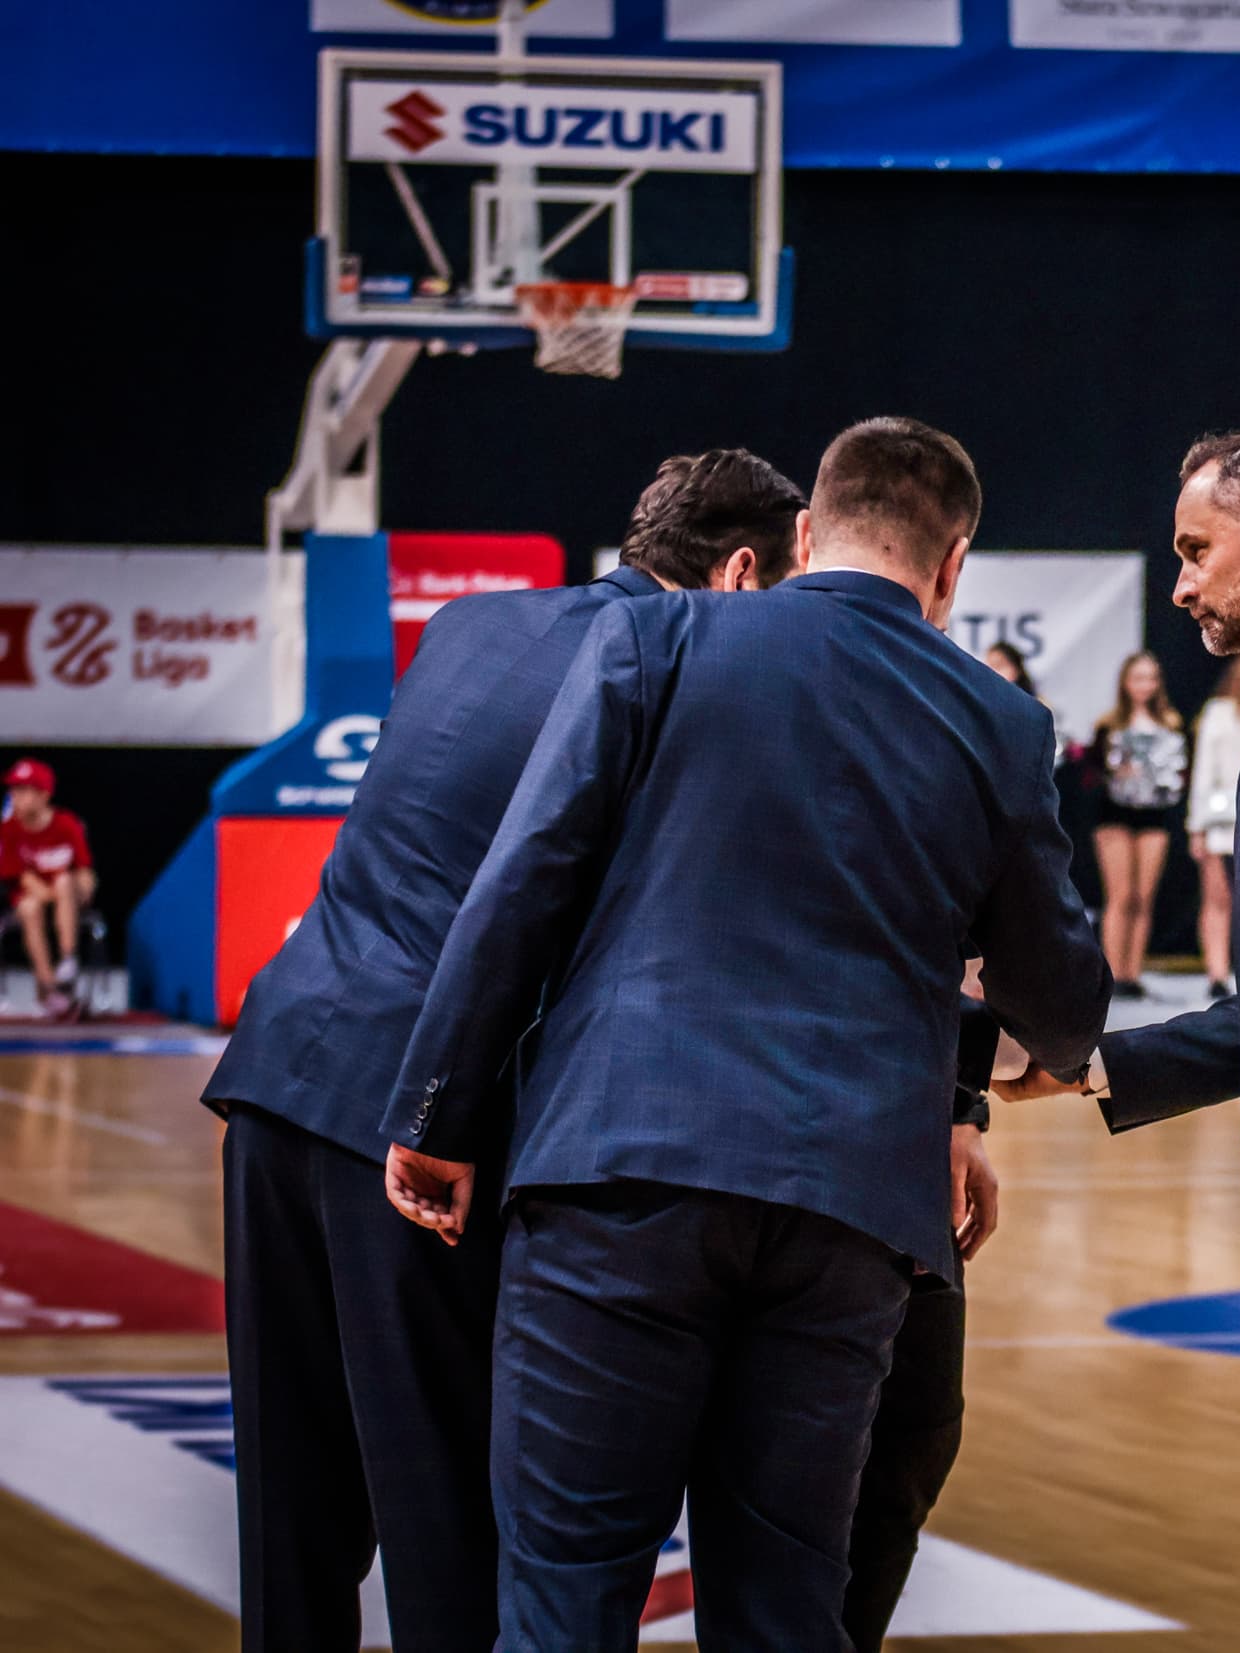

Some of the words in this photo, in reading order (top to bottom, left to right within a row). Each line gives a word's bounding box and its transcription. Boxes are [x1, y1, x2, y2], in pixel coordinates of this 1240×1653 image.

[464, 103, 725, 153] SUZUKI
[133, 607, 257, 642] Basket
[951, 612, 1044, 658] TIS
[133, 649, 210, 687] Liga
